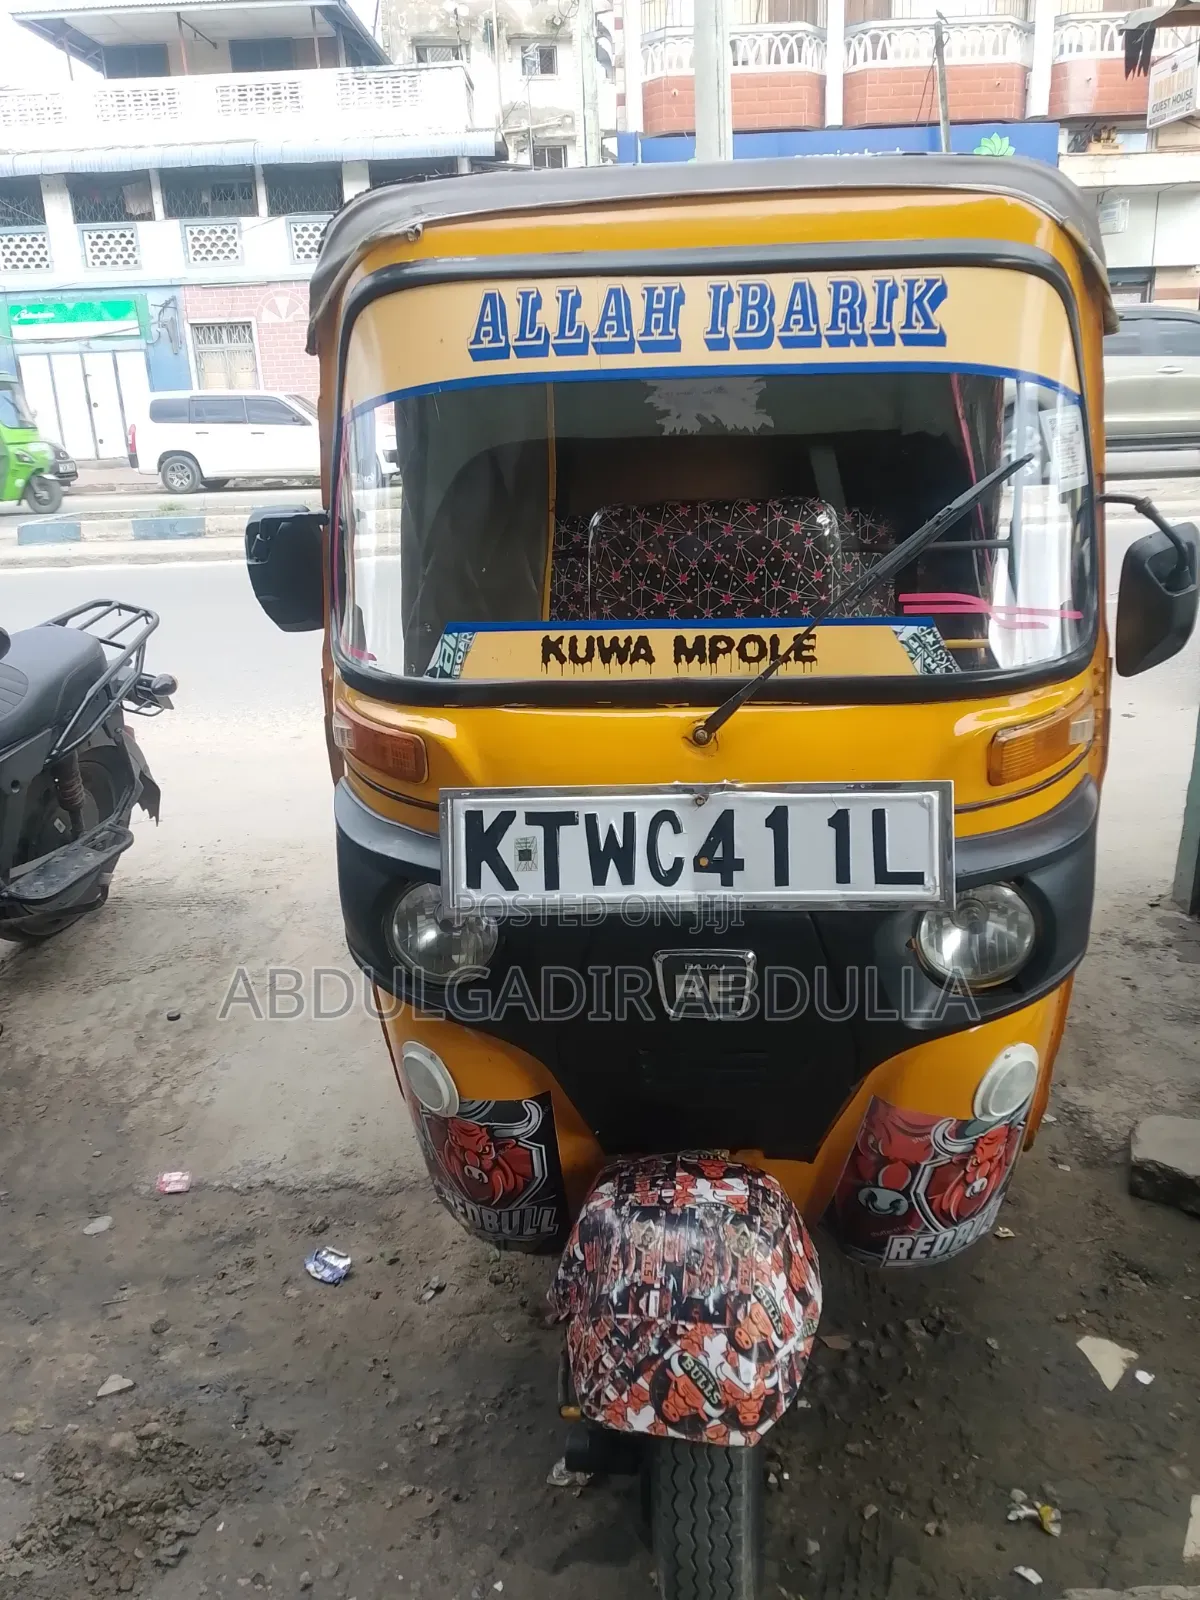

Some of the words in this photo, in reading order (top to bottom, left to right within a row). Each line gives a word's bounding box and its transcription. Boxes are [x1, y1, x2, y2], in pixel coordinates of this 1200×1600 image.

[1152, 98, 1171, 113] GUEST
[1171, 88, 1193, 105] HOUSE
[466, 282, 686, 362] ALLAH
[703, 275, 948, 352] IBARIK
[540, 634, 656, 675] KUWA
[672, 632, 818, 676] MPOLE
[754, 1285, 782, 1335] BULLS
[682, 1356, 721, 1405] BULLS
